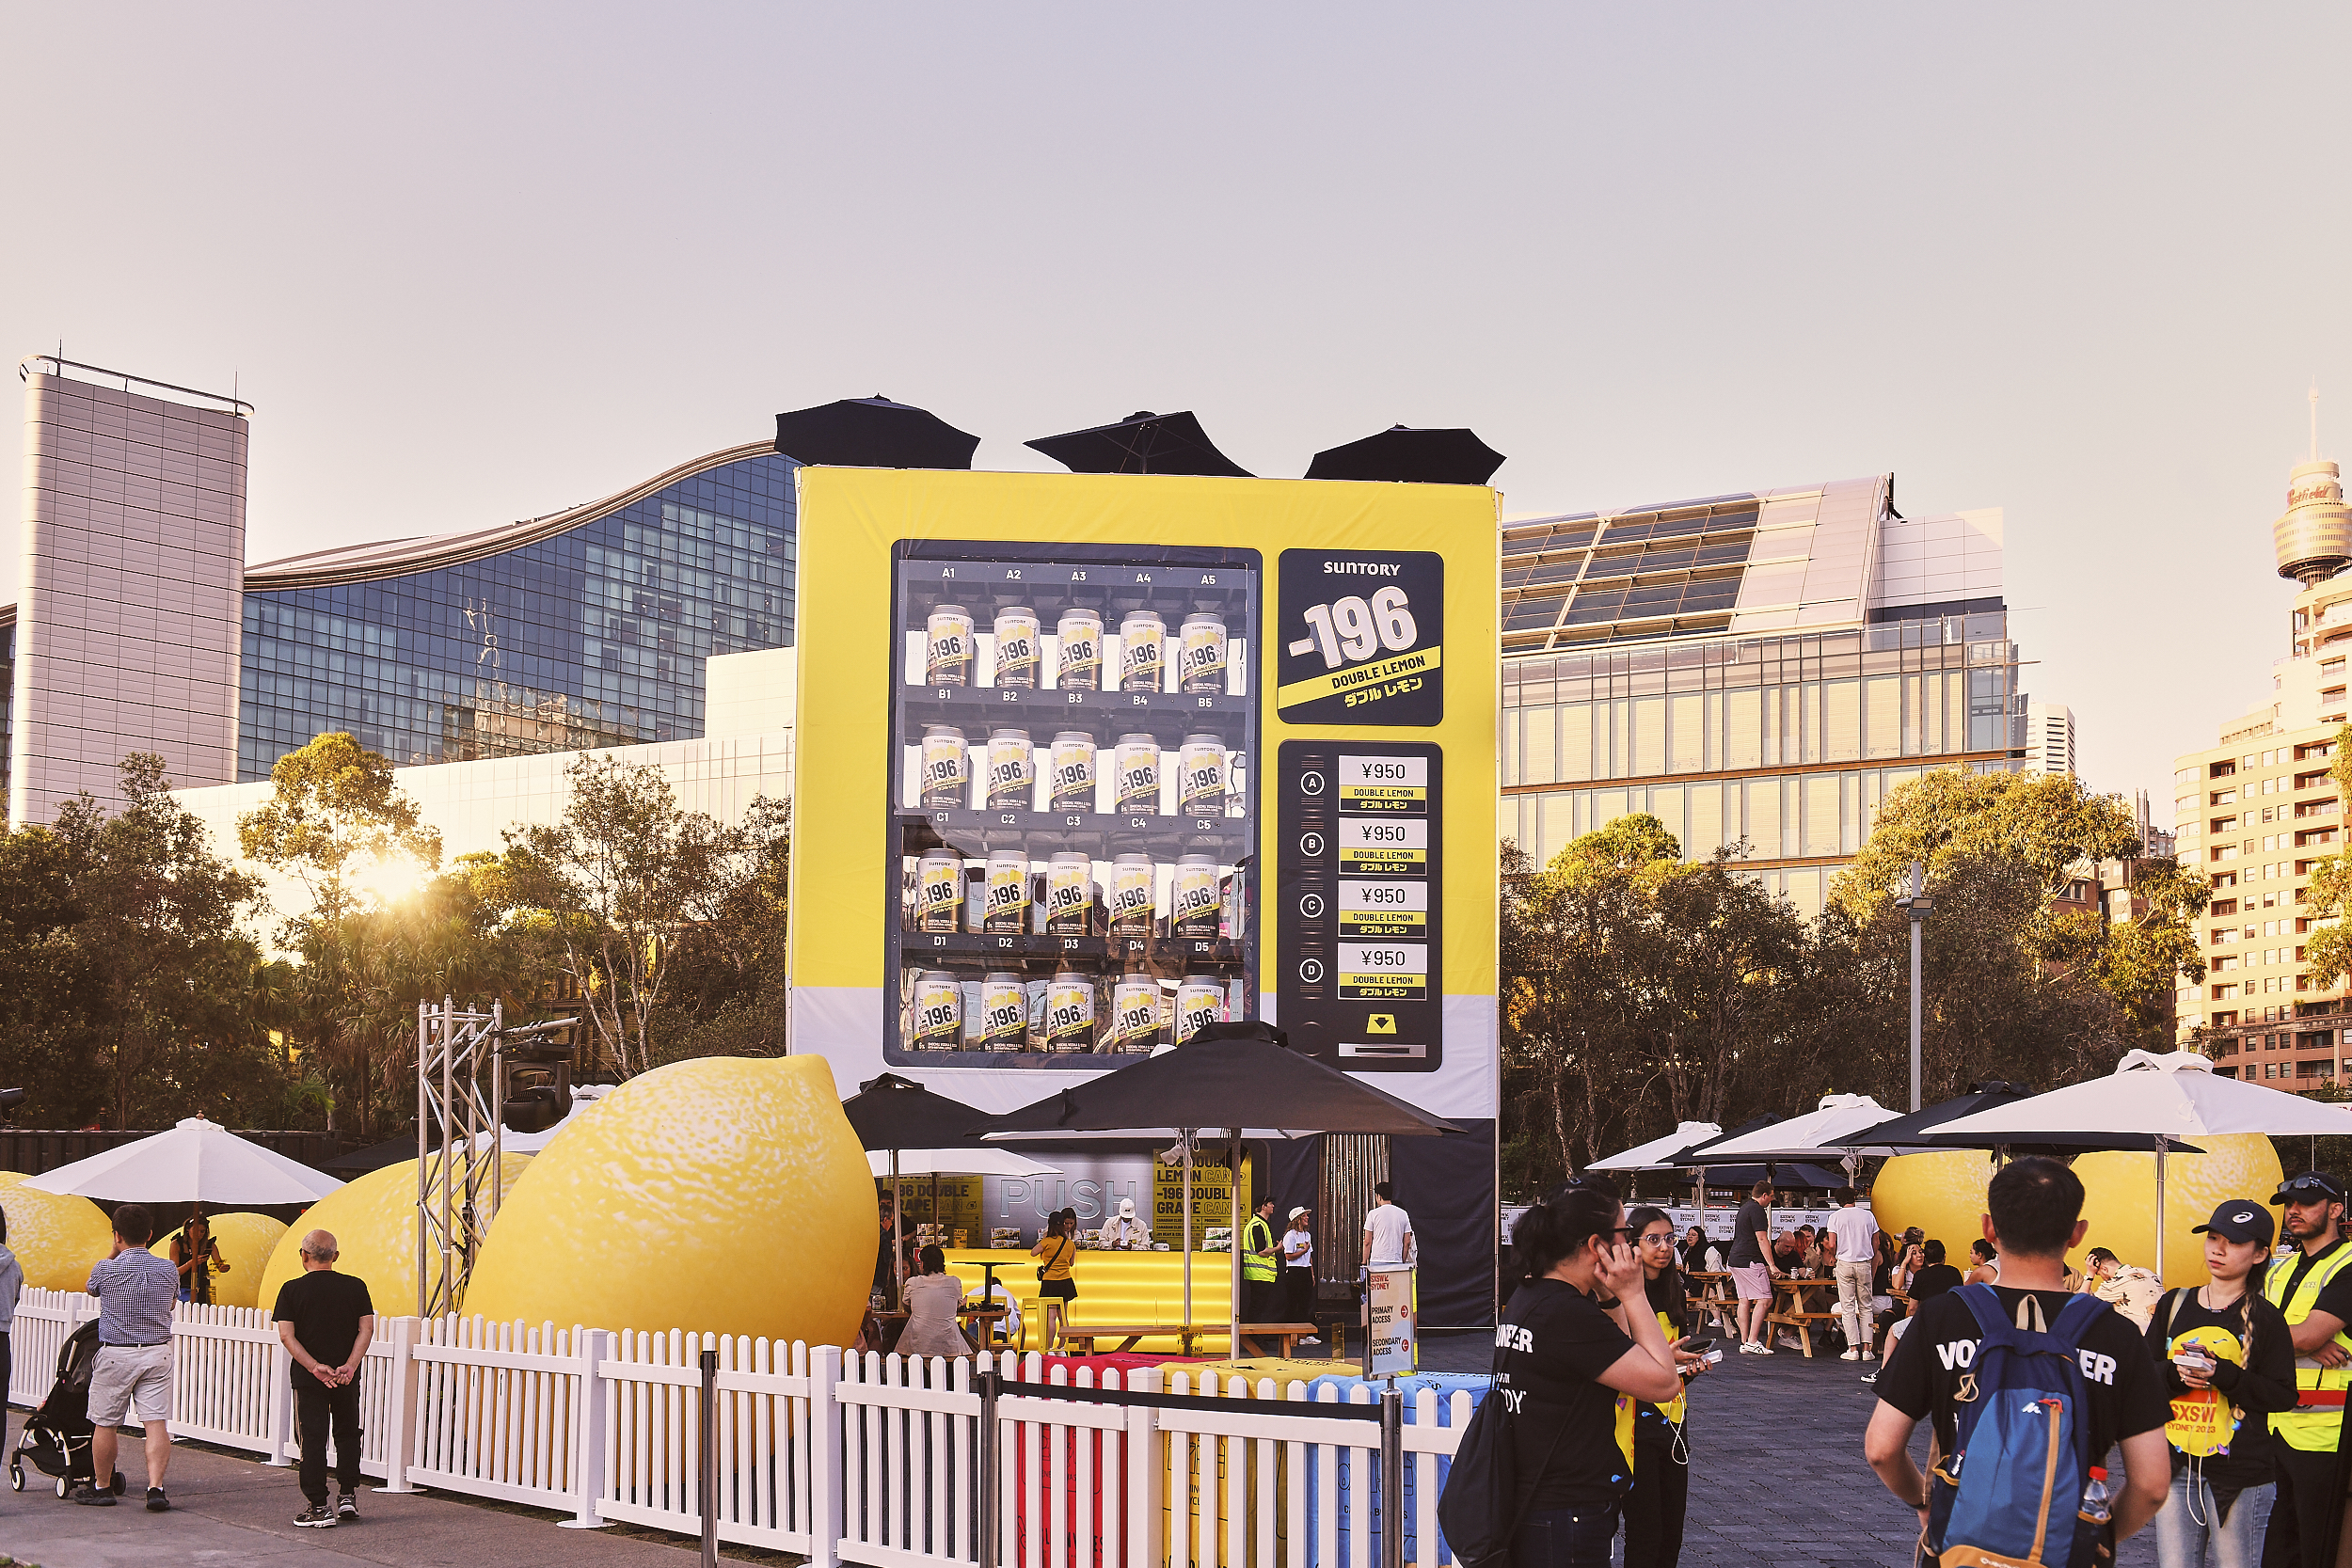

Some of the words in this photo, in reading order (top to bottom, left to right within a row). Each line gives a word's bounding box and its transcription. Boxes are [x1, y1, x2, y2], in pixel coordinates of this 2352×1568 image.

[942, 568, 954, 578] A1
[1323, 561, 1402, 577] SUNTORY
[1007, 570, 1021, 579] A2
[1072, 572, 1086, 580] A3
[1136, 574, 1151, 582] A4
[1201, 575, 1216, 584] A5
[1288, 585, 1418, 669] -196
[1331, 666, 1381, 689] DOUBLE
[1382, 655, 1426, 676] LEMON
[939, 689, 950, 699] B1
[1003, 691, 1017, 701] B2
[1069, 693, 1082, 703] B3
[1134, 696, 1147, 705] B4
[1199, 698, 1212, 707] B5
[1361, 763, 1406, 779] ¥950
[1308, 778, 1317, 788] A
[1387, 789, 1414, 798] LEMON
[937, 813, 948, 821] C1
[1001, 815, 1015, 824] C2
[1067, 816, 1080, 826] C3
[1132, 818, 1146, 828] C4
[1198, 820, 1211, 830] C5
[1361, 826, 1406, 841] ¥950
[1308, 838, 1316, 849] B
[1387, 851, 1414, 860] LEMON
[1361, 888, 1406, 904] ¥950
[1308, 900, 1316, 911] C
[1387, 913, 1414, 922] LEMON
[934, 937, 946, 945] D1
[999, 938, 1012, 947] D2
[1065, 939, 1078, 948] D3
[1130, 941, 1144, 950] D4
[1196, 942, 1208, 951] D5
[1361, 950, 1406, 966] ¥950
[1308, 965, 1315, 975] D
[1353, 975, 1384, 984] DOUBLE
[1157, 1170, 1201, 1182] LEMN
[1205, 1170, 1232, 1182] CAN
[1156, 1187, 1184, 1199] -196
[1190, 1187, 1232, 1200] DOUBL
[1000, 1179, 1136, 1219] PUSH
[1157, 1202, 1201, 1214] GRAE
[1204, 1202, 1232, 1214] CAN
[1371, 1282, 1390, 1291] SYDNEY
[1371, 1306, 1393, 1315] PRIMARY
[1372, 1315, 1391, 1324] ACCESS
[1372, 1337, 1402, 1347] SECONDARY
[1373, 1347, 1392, 1356] ACCESS
[2170, 1403, 2217, 1423] SXSW
[2167, 1421, 2194, 1433] SYDNEY
